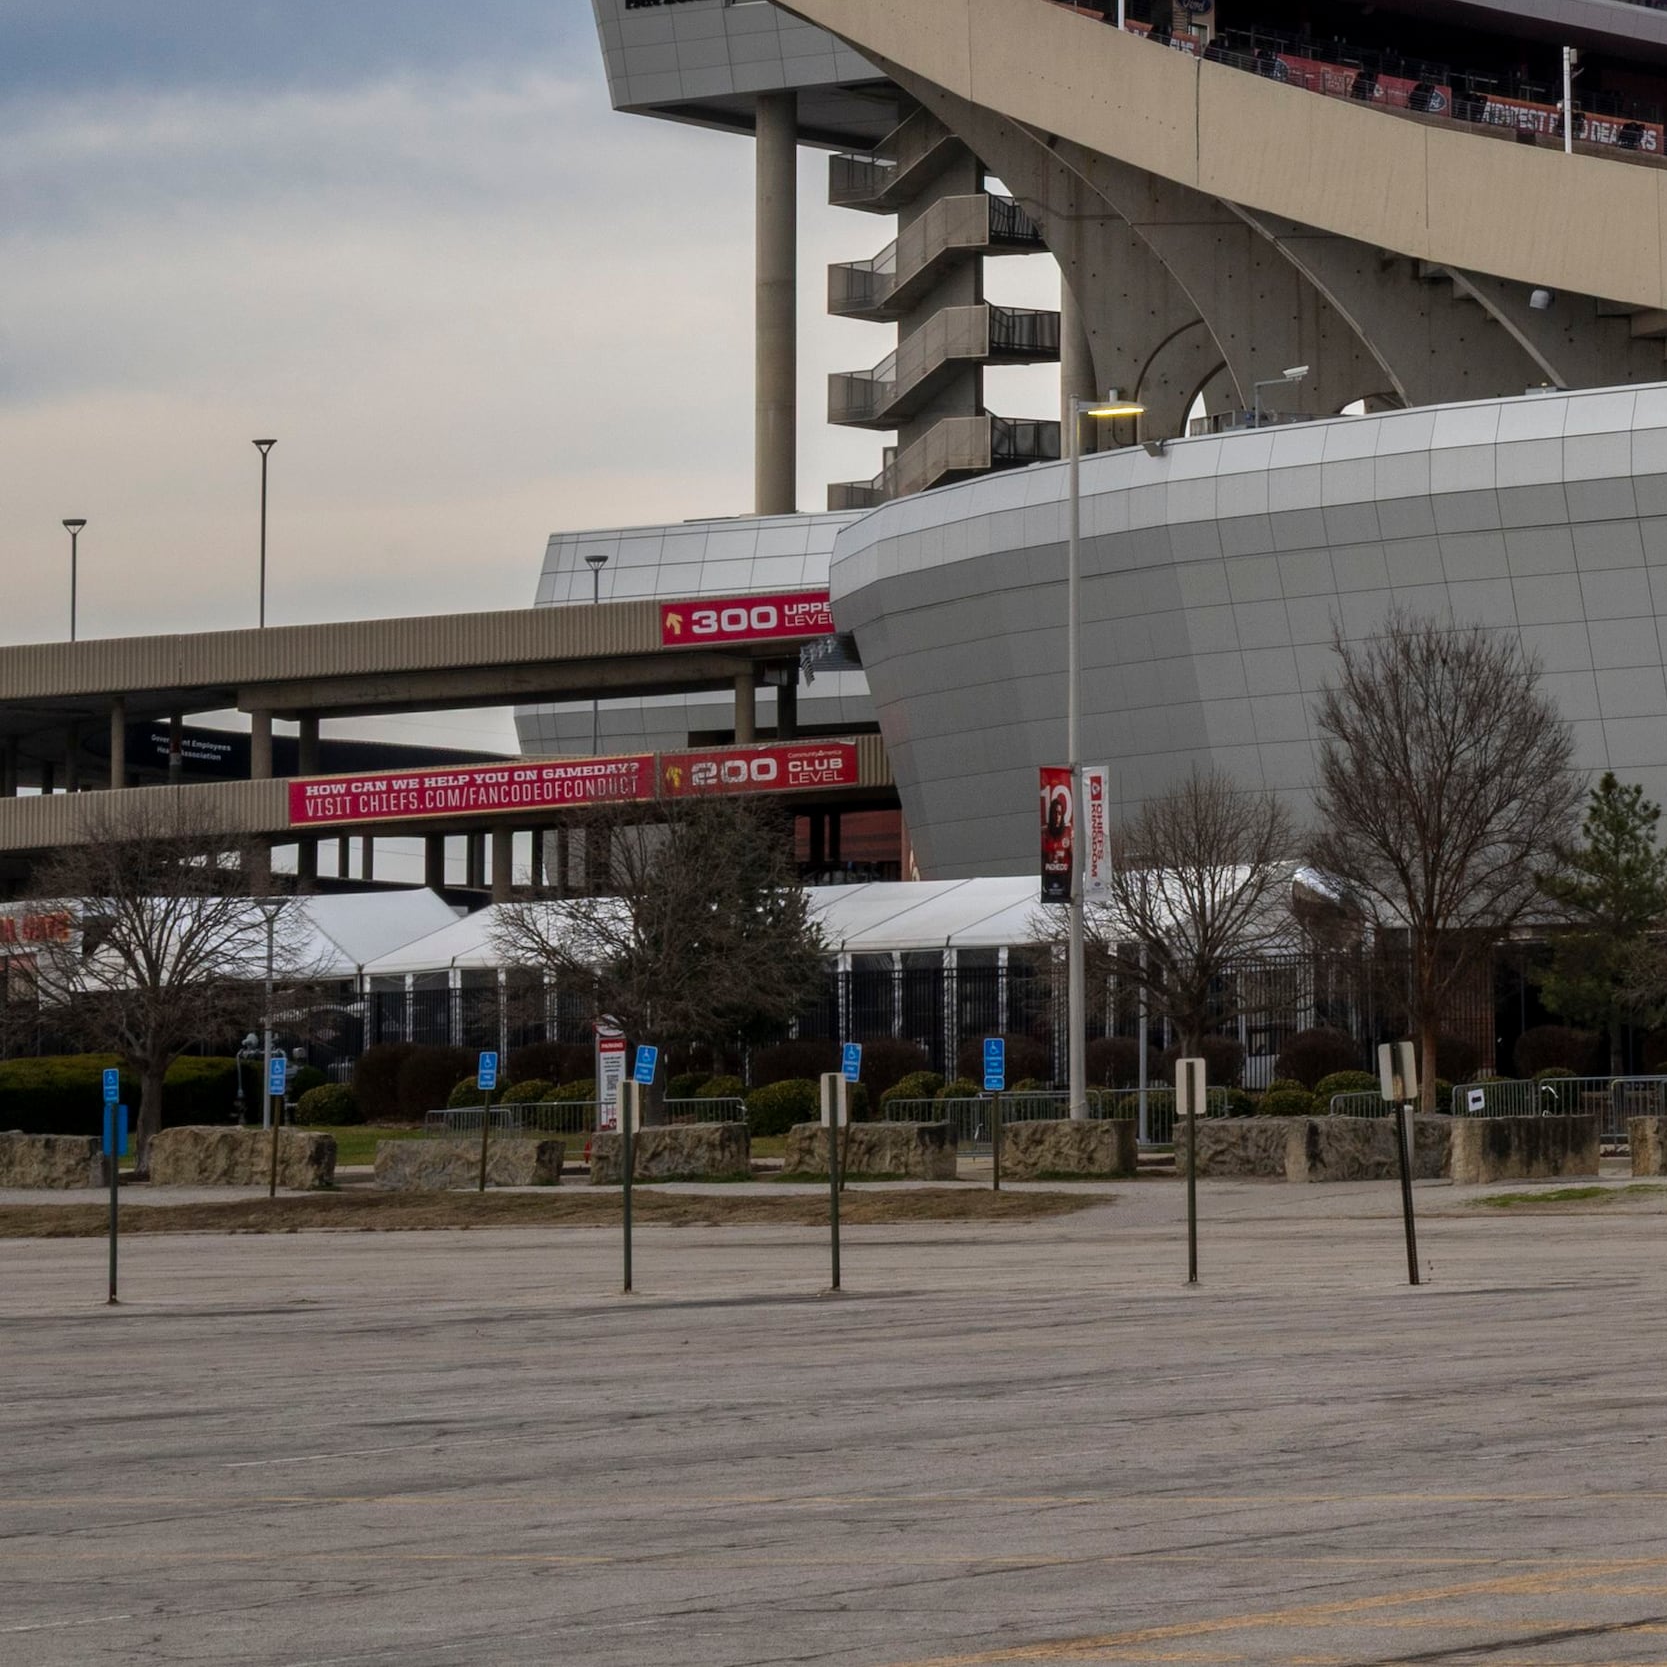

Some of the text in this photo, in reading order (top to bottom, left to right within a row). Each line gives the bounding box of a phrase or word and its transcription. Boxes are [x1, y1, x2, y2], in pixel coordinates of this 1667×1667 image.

[691, 606, 777, 634] 300
[691, 758, 778, 786] 200
[788, 758, 843, 772] CLUB
[789, 770, 844, 785] LEVEL
[305, 763, 640, 796] HOW CAN WE HELP YOU ON GAMEDAY?
[305, 775, 639, 817] VISIT CHIEFS.COM/FANCODEOFCONDUCT
[1040, 785, 1073, 827] 10
